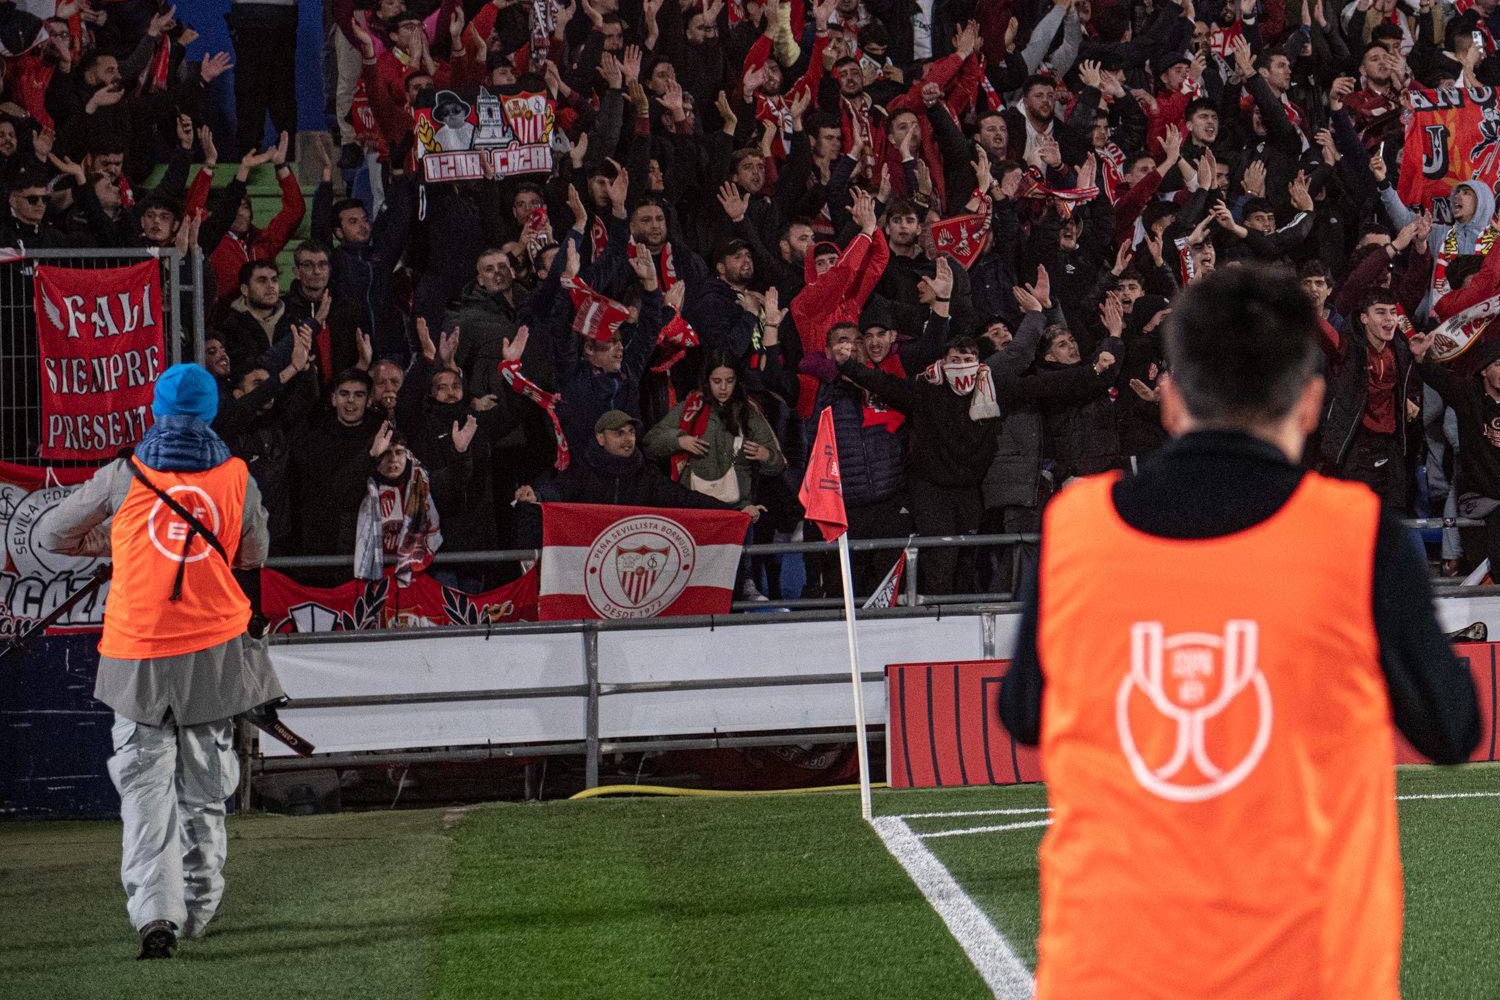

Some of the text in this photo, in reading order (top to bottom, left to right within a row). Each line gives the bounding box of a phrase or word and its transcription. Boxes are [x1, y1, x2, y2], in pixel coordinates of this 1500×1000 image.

[1422, 125, 1449, 175] J
[62, 283, 155, 338] FALI
[44, 345, 160, 395] SIEMPRE
[48, 405, 148, 450] PRESENT
[14, 504, 39, 555] SEVILLA
[611, 521, 658, 540] SEVILLISTA
